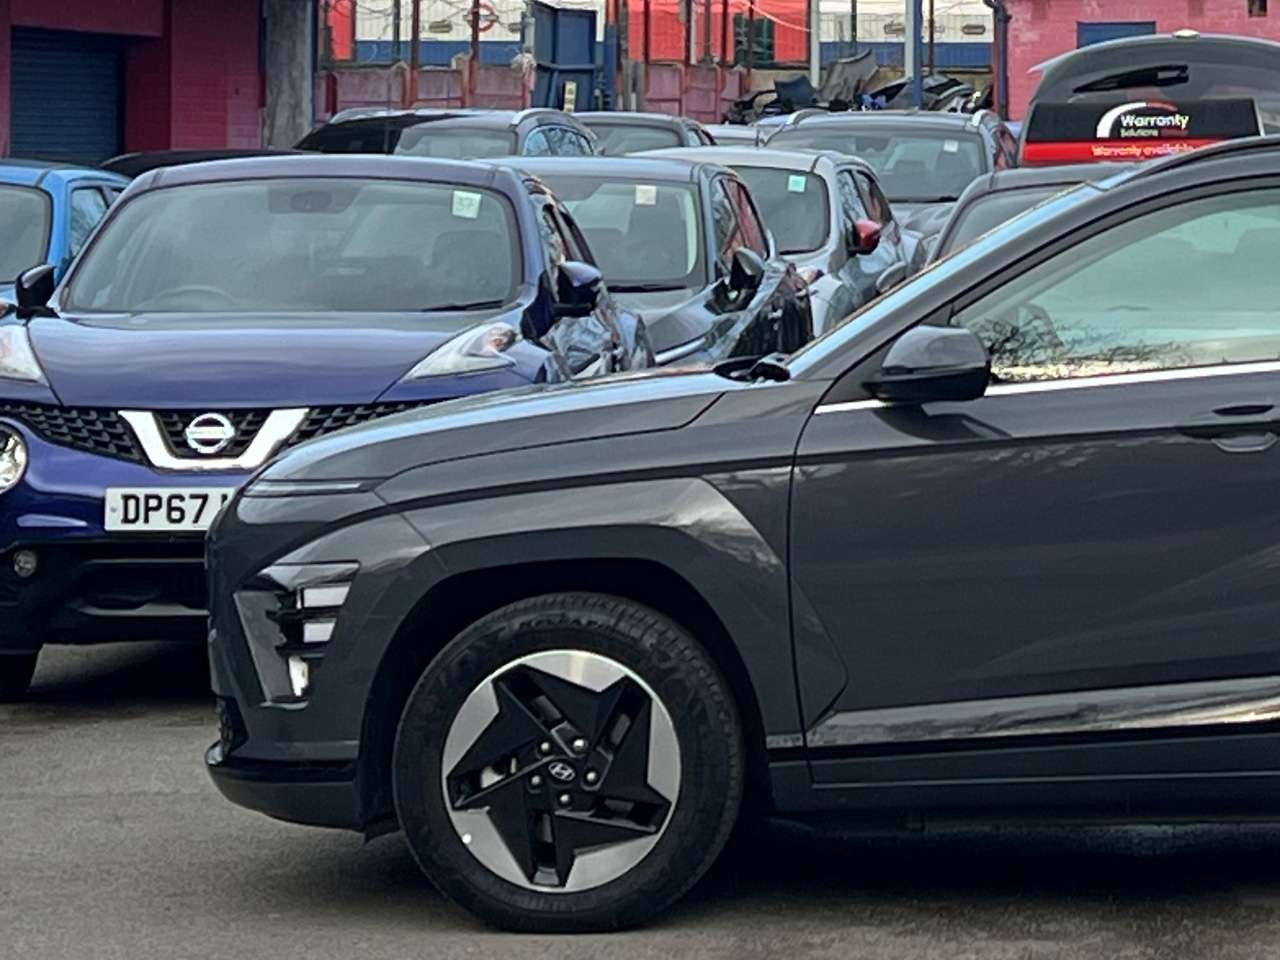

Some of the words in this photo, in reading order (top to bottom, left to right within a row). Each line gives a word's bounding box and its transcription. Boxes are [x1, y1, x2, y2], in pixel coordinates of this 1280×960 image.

[1120, 113, 1190, 130] Warranty
[1092, 145, 1142, 156] Warranty
[120, 493, 209, 525] DP67
